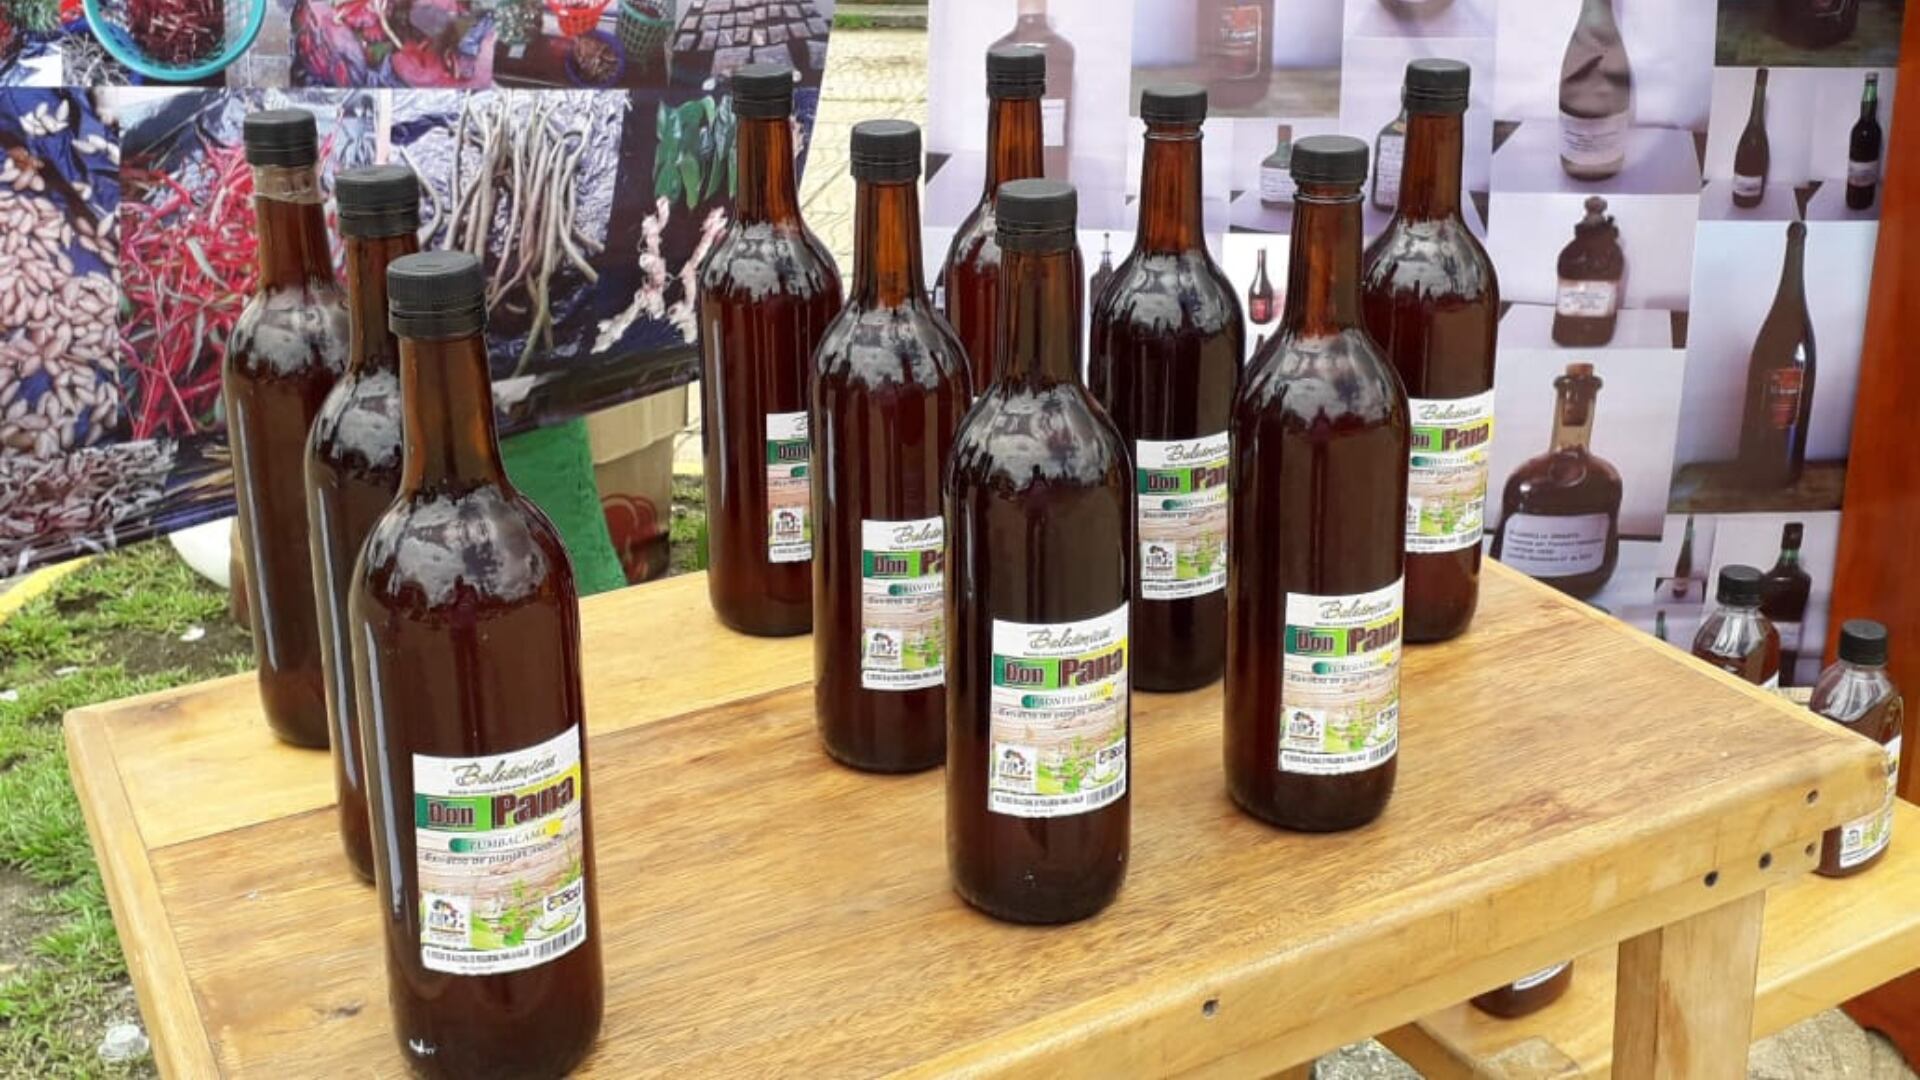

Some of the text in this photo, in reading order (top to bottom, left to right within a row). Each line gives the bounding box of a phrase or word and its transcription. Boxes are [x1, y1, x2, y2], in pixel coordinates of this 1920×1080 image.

[1411, 422, 1489, 451] on Pana
[1149, 466, 1227, 491] Don Pan
[874, 555, 907, 573] Don
[1297, 630, 1334, 652] Don
[1348, 616, 1400, 653] Pana
[1006, 661, 1044, 683] Don
[1060, 647, 1123, 688] Pana
[428, 801, 476, 826] Don
[495, 775, 575, 827] Pana
